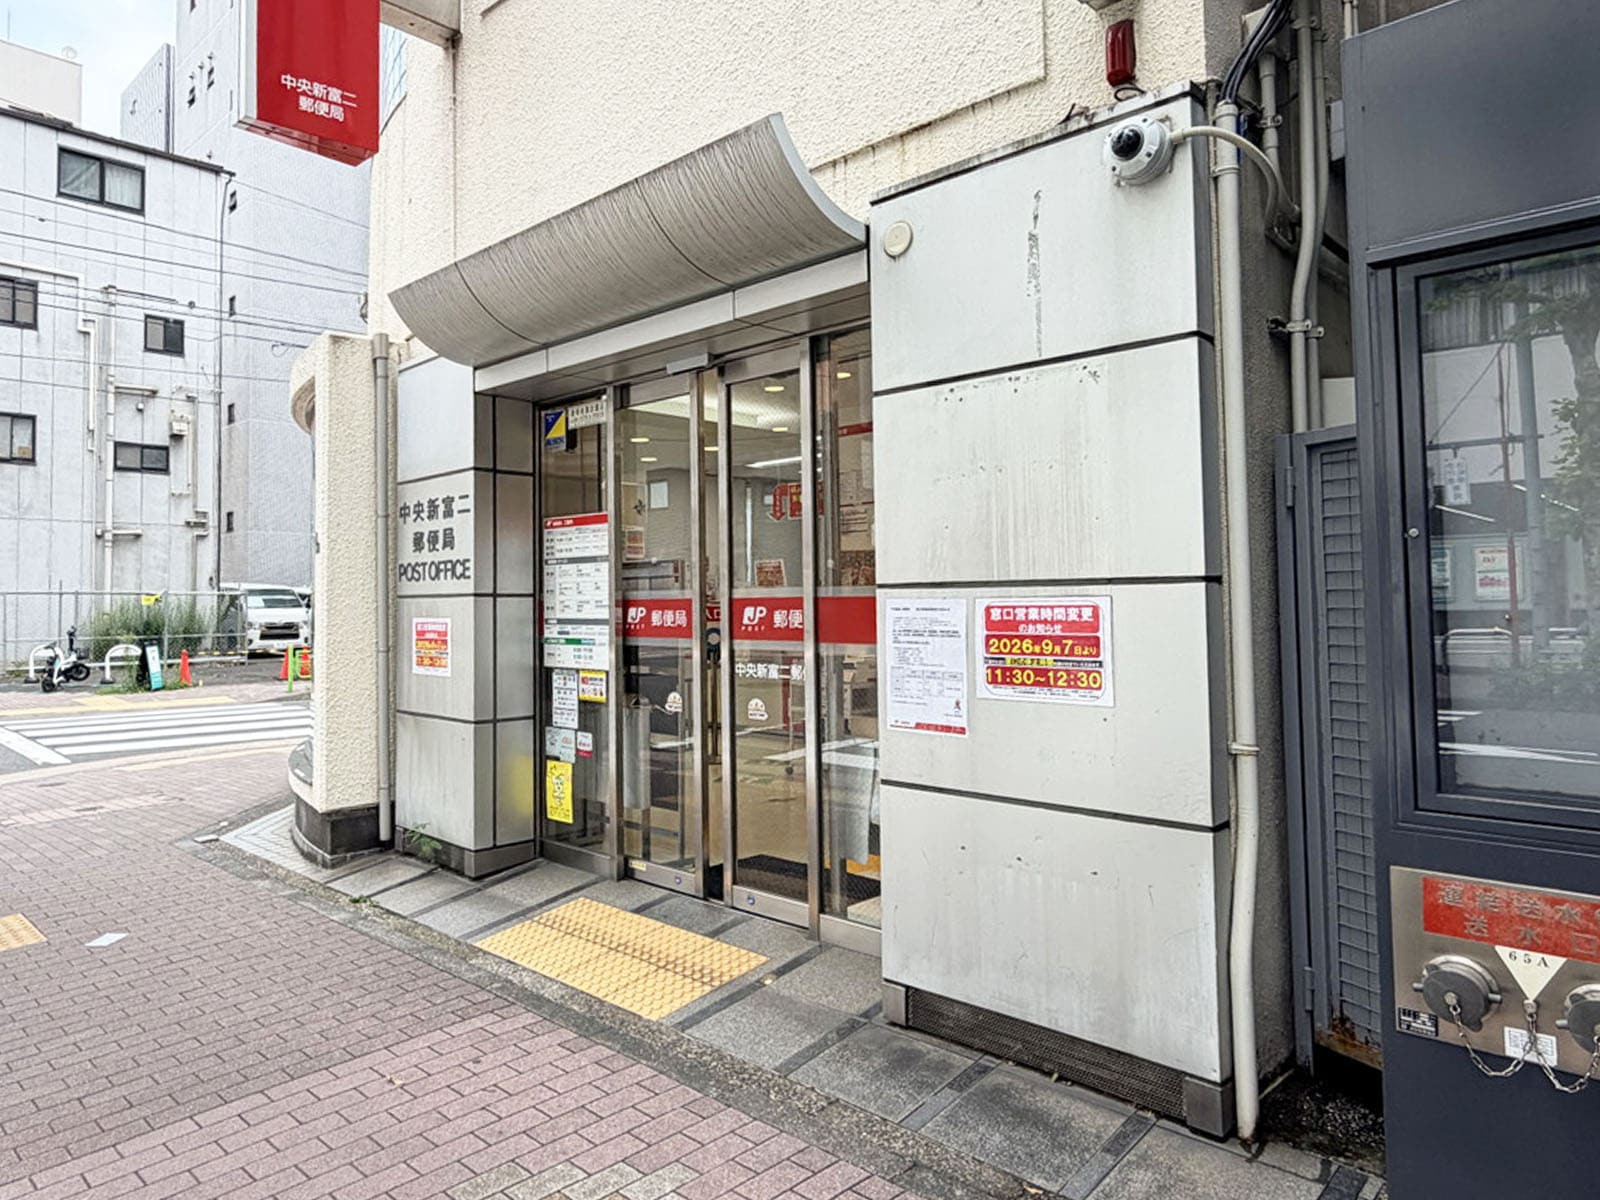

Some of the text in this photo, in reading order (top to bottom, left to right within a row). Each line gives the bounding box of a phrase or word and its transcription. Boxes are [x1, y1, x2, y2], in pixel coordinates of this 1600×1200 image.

[281, 74, 357, 108] 中央新富二
[298, 95, 345, 122] 郵便局
[399, 494, 471, 525] 中央新富二
[412, 527, 455, 554] 郵便局
[398, 559, 471, 582] POST OFFICE
[651, 609, 688, 627] 郵便局
[990, 607, 1094, 622] 窓口営業時間変更
[1438, 880, 1600, 930] 連結送水
[1464, 912, 1598, 957] 送水口
[1508, 950, 1550, 969] 65A
